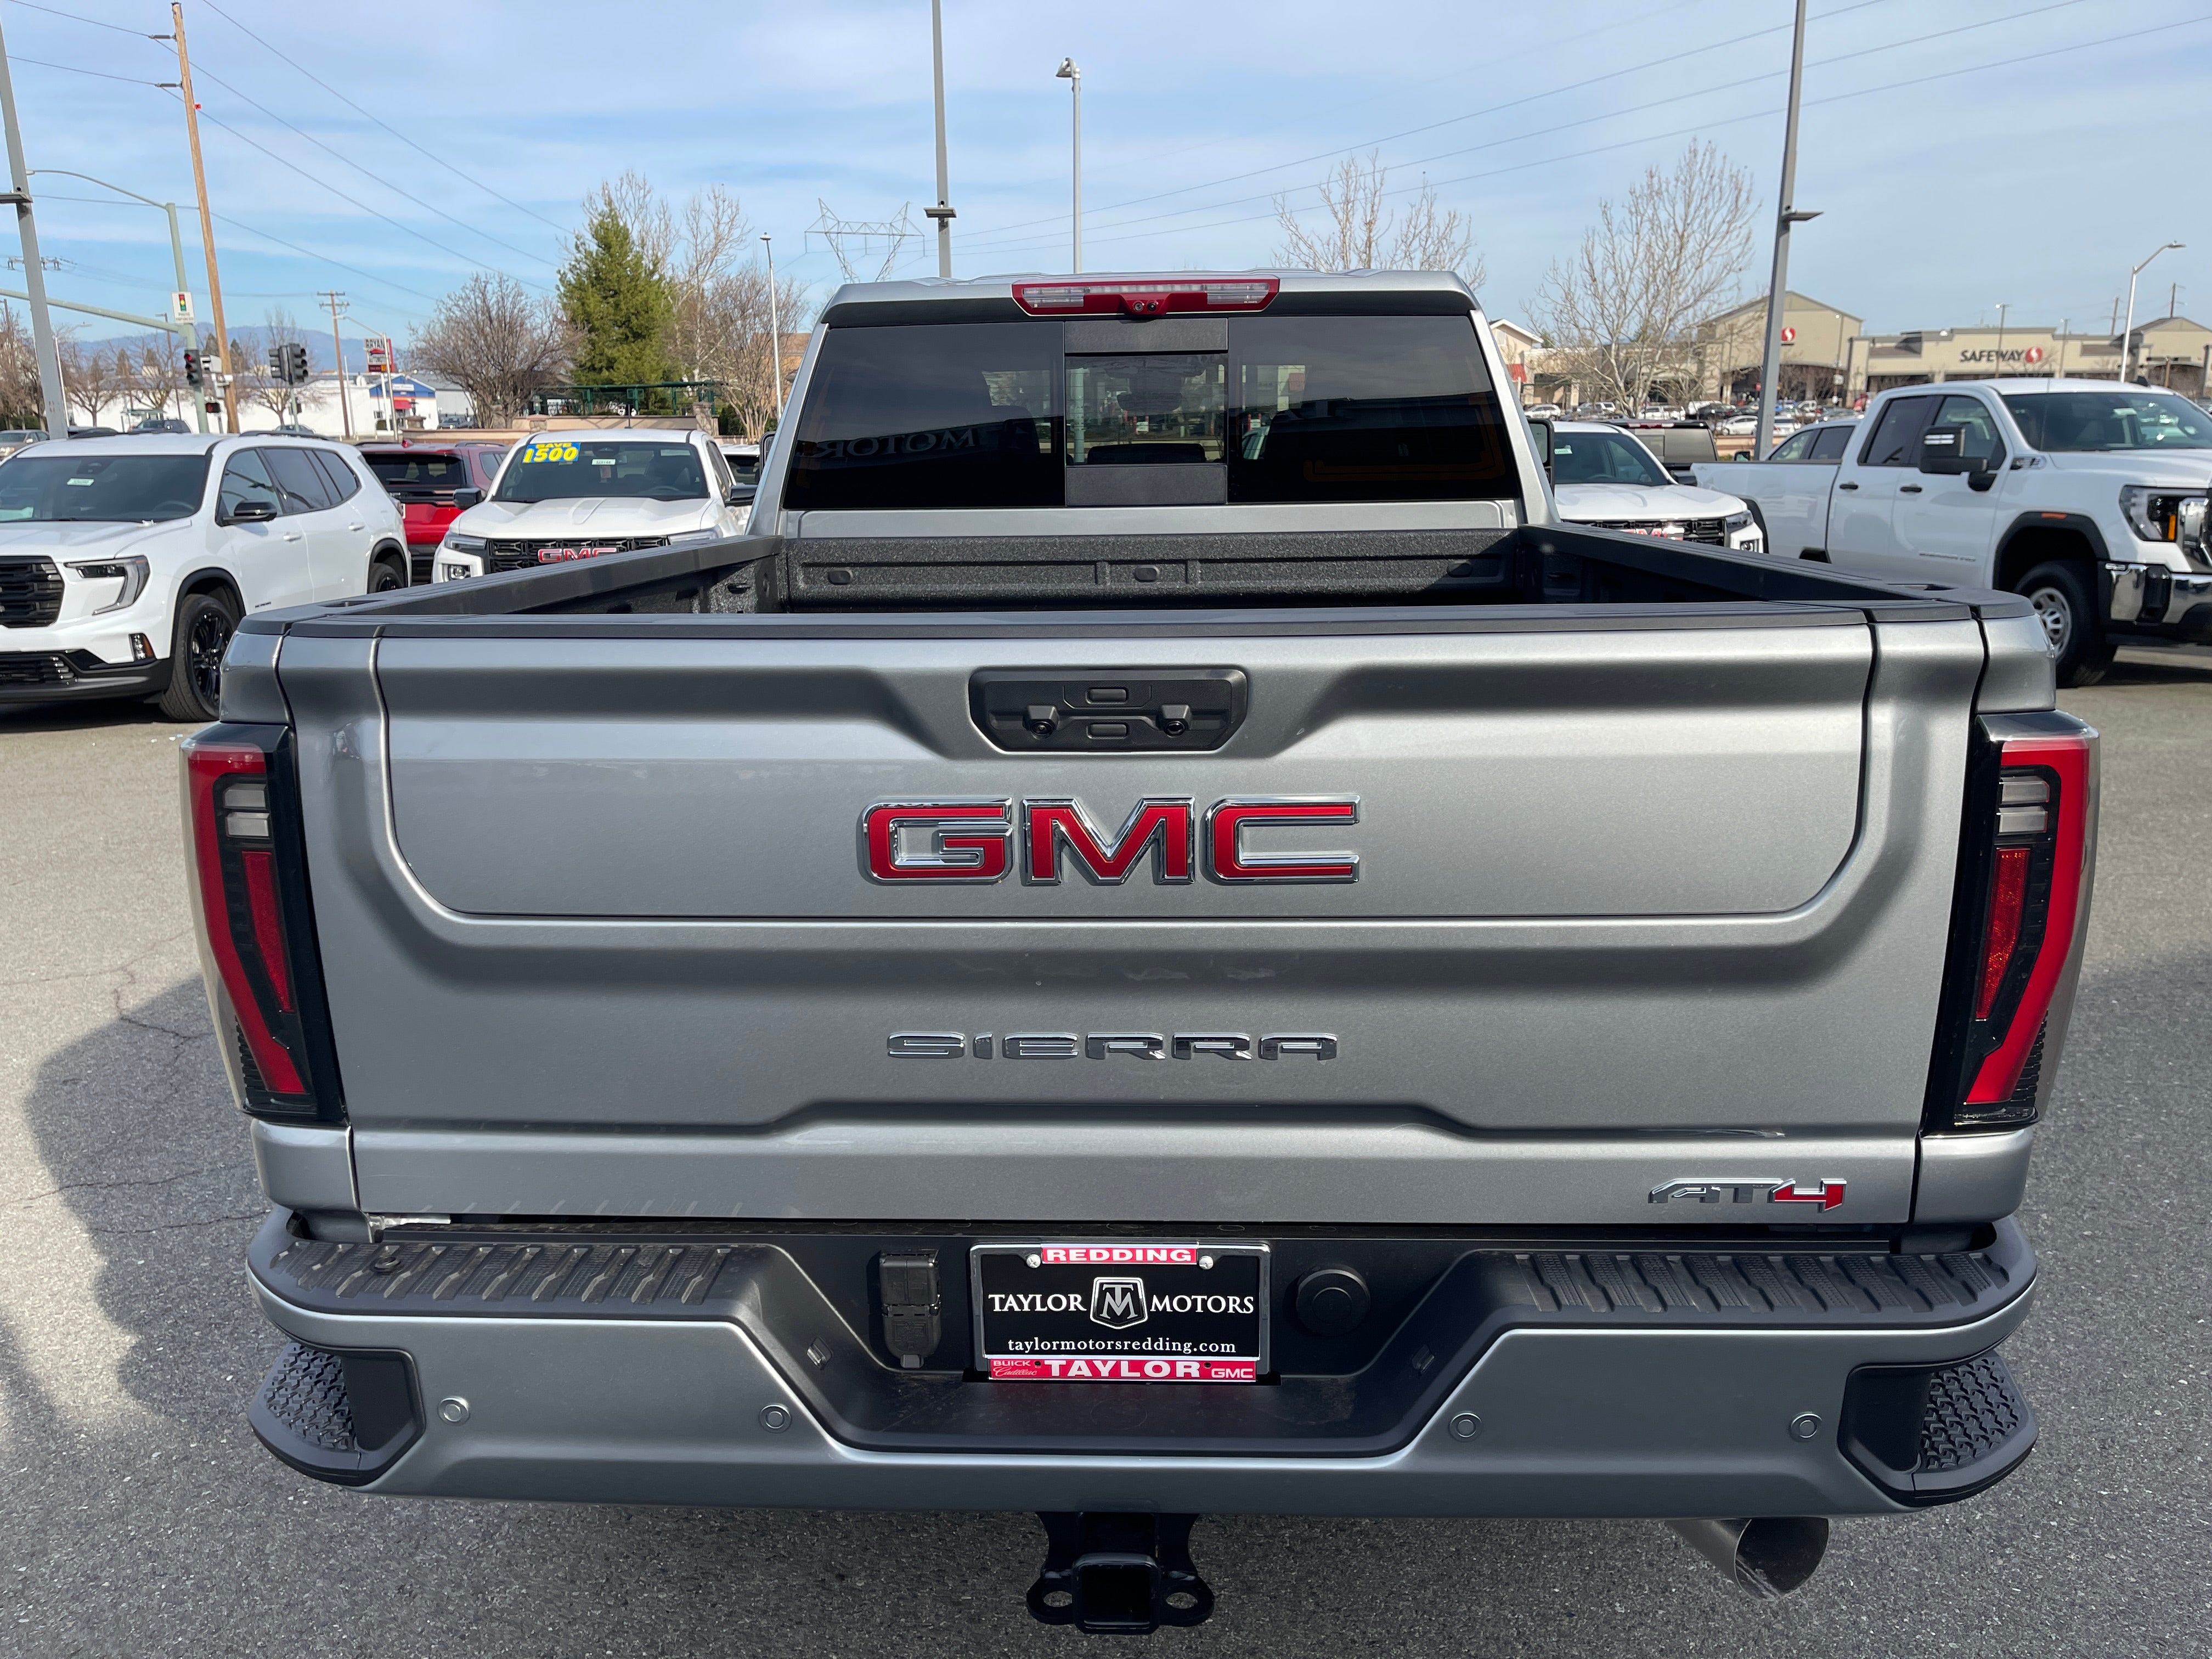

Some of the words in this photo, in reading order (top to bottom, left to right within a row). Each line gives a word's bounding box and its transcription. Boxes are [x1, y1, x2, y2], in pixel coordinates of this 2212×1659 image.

[1960, 350, 2024, 362] SAFEWAY
[523, 447, 578, 462] 1500
[862, 795, 1361, 885] GMC
[887, 1032, 1338, 1060] SIERRA
[1648, 1178, 1847, 1213] AT4
[1047, 1249, 1192, 1262] REDDING
[988, 1294, 1087, 1312] TAYLOR
[1150, 1295, 1254, 1314] MOTORS
[1008, 1338, 1237, 1353] taylormotorsredding.com
[992, 1367, 1037, 1376] Cadillac
[1045, 1360, 1201, 1378] TAYLOR
[1211, 1368, 1253, 1378] GMC
